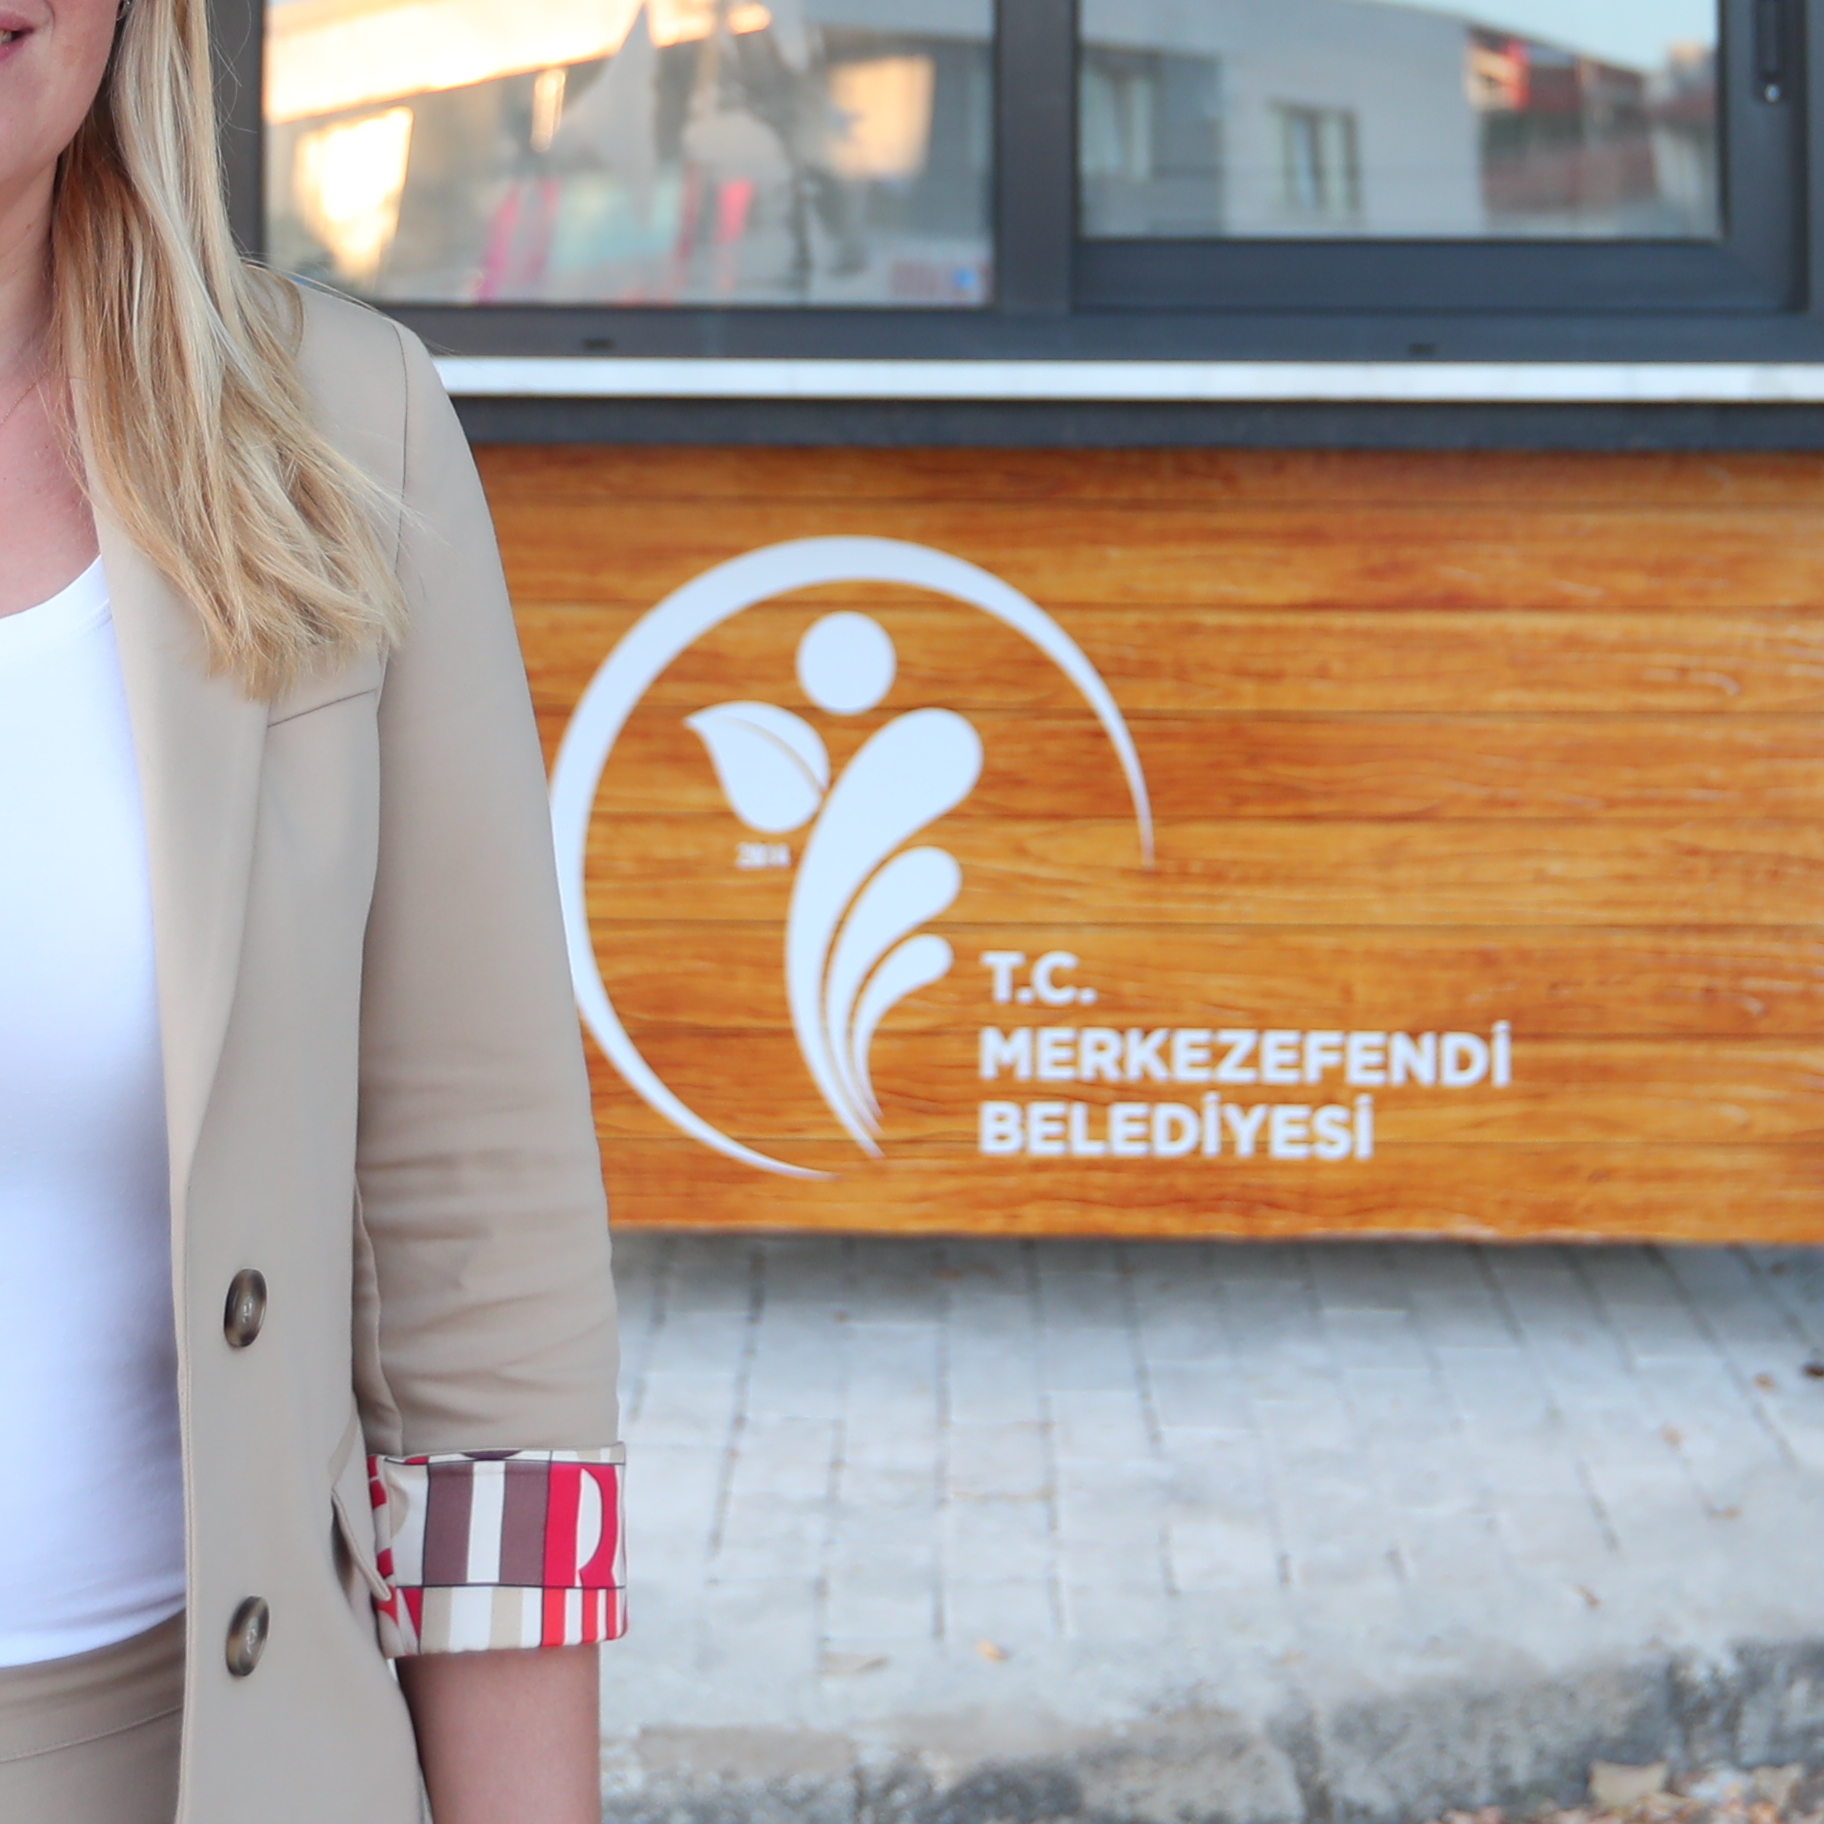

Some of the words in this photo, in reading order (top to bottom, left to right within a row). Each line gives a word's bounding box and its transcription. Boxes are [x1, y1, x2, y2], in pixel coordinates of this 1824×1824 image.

[979, 950, 1098, 1006] T.C.
[978, 1019, 1513, 1088] MERKEZEFENDİ
[978, 1090, 1374, 1160] BELEDİYESİ
